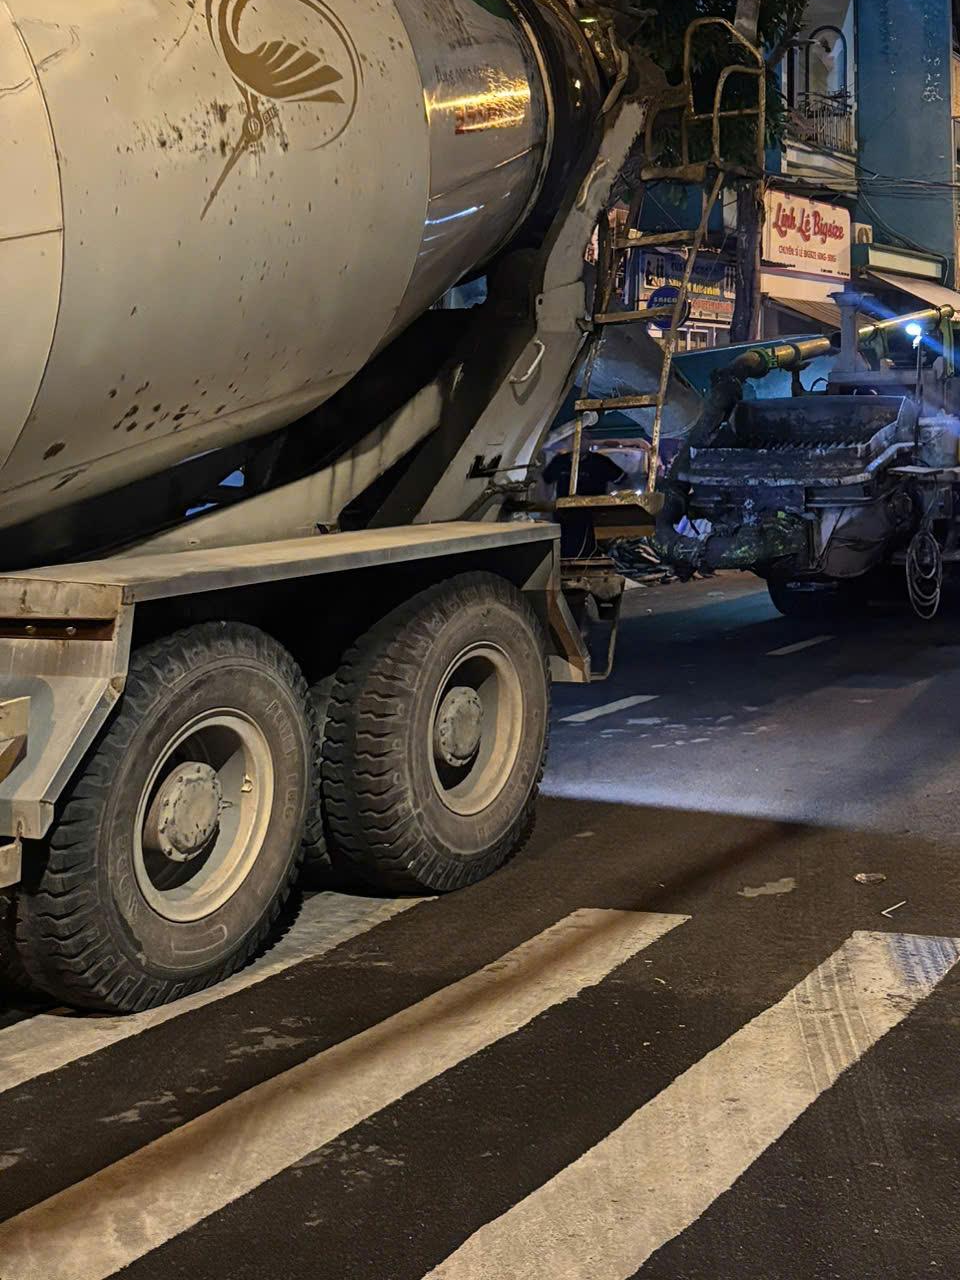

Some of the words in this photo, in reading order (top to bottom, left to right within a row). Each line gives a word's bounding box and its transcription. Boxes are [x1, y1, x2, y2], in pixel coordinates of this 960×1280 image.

[773, 202, 797, 238] Linh
[796, 208, 812, 242] Lê
[812, 210, 845, 245] Bigsize
